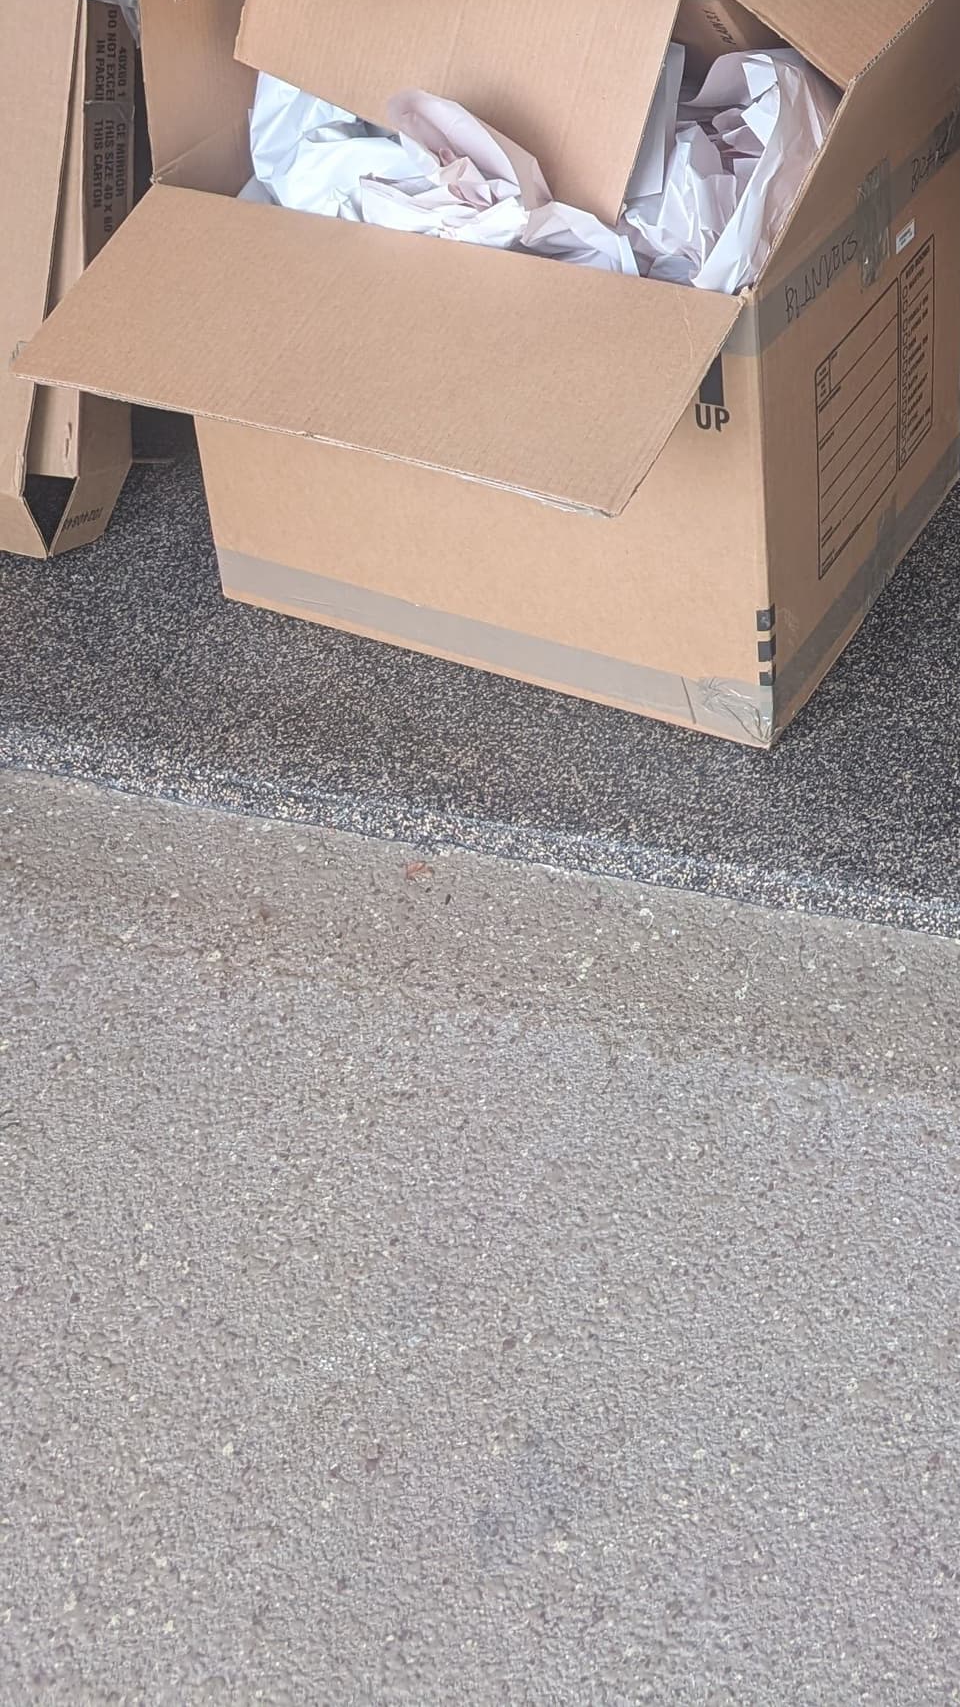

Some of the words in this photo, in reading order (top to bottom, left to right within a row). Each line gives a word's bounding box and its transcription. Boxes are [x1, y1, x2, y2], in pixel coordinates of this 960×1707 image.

[106, 33, 117, 58] NOT
[94, 119, 104, 151] THIS
[92, 154, 103, 209] CARTON
[104, 152, 114, 182] SIZE
[694, 403, 731, 433] UP
